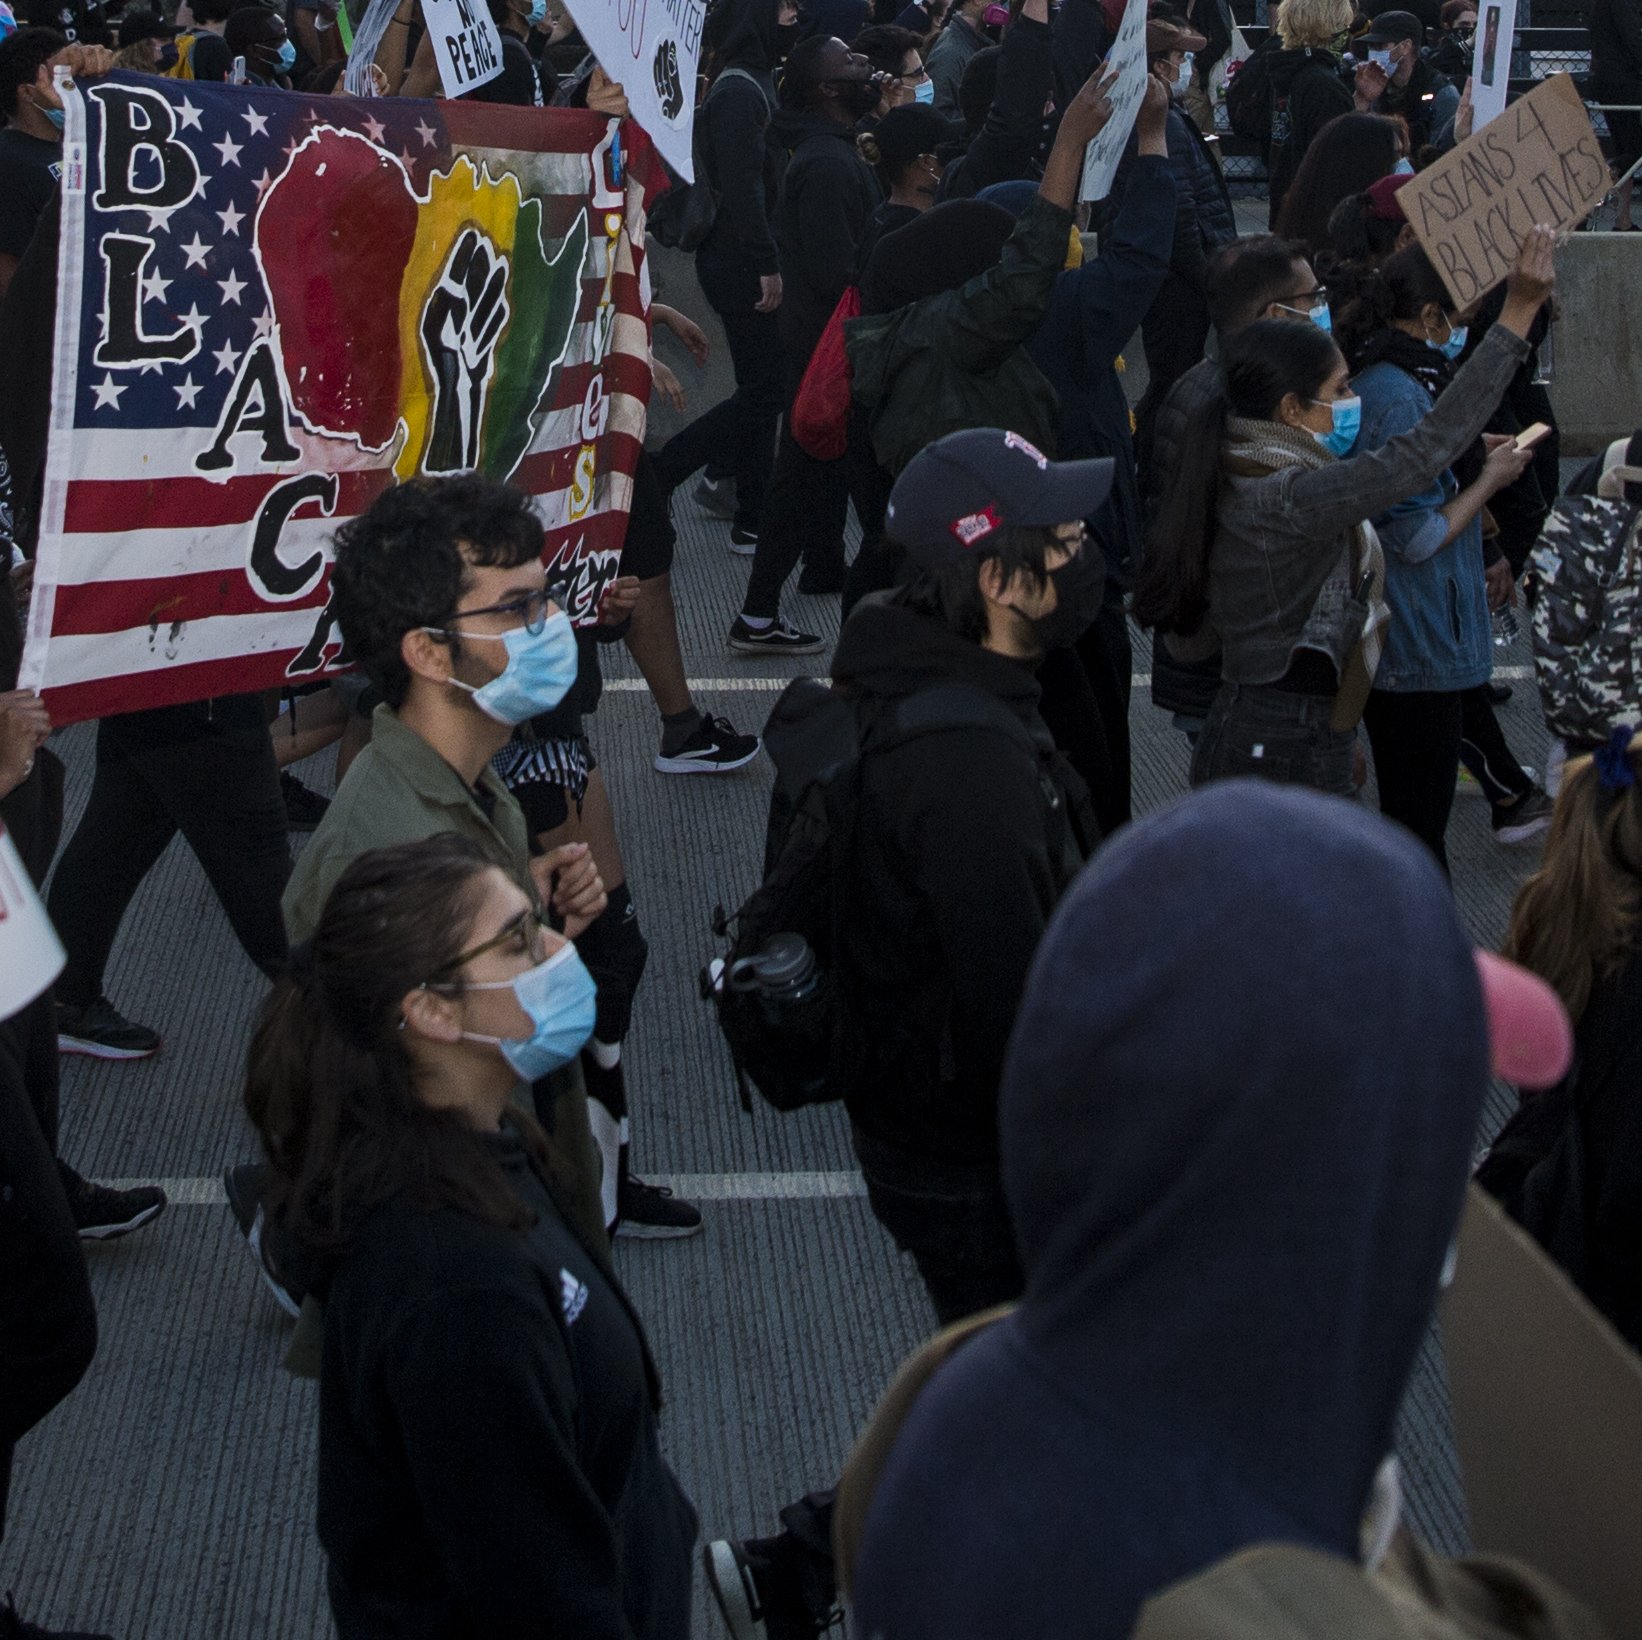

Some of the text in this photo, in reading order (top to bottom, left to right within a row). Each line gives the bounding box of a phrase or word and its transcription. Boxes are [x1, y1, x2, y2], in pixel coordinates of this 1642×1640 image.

[446, 20, 498, 84] PEACE
[1418, 101, 1555, 237] ASIANS 4
[1436, 198, 1529, 302] BLACK
[88, 83, 355, 677] BLAC
